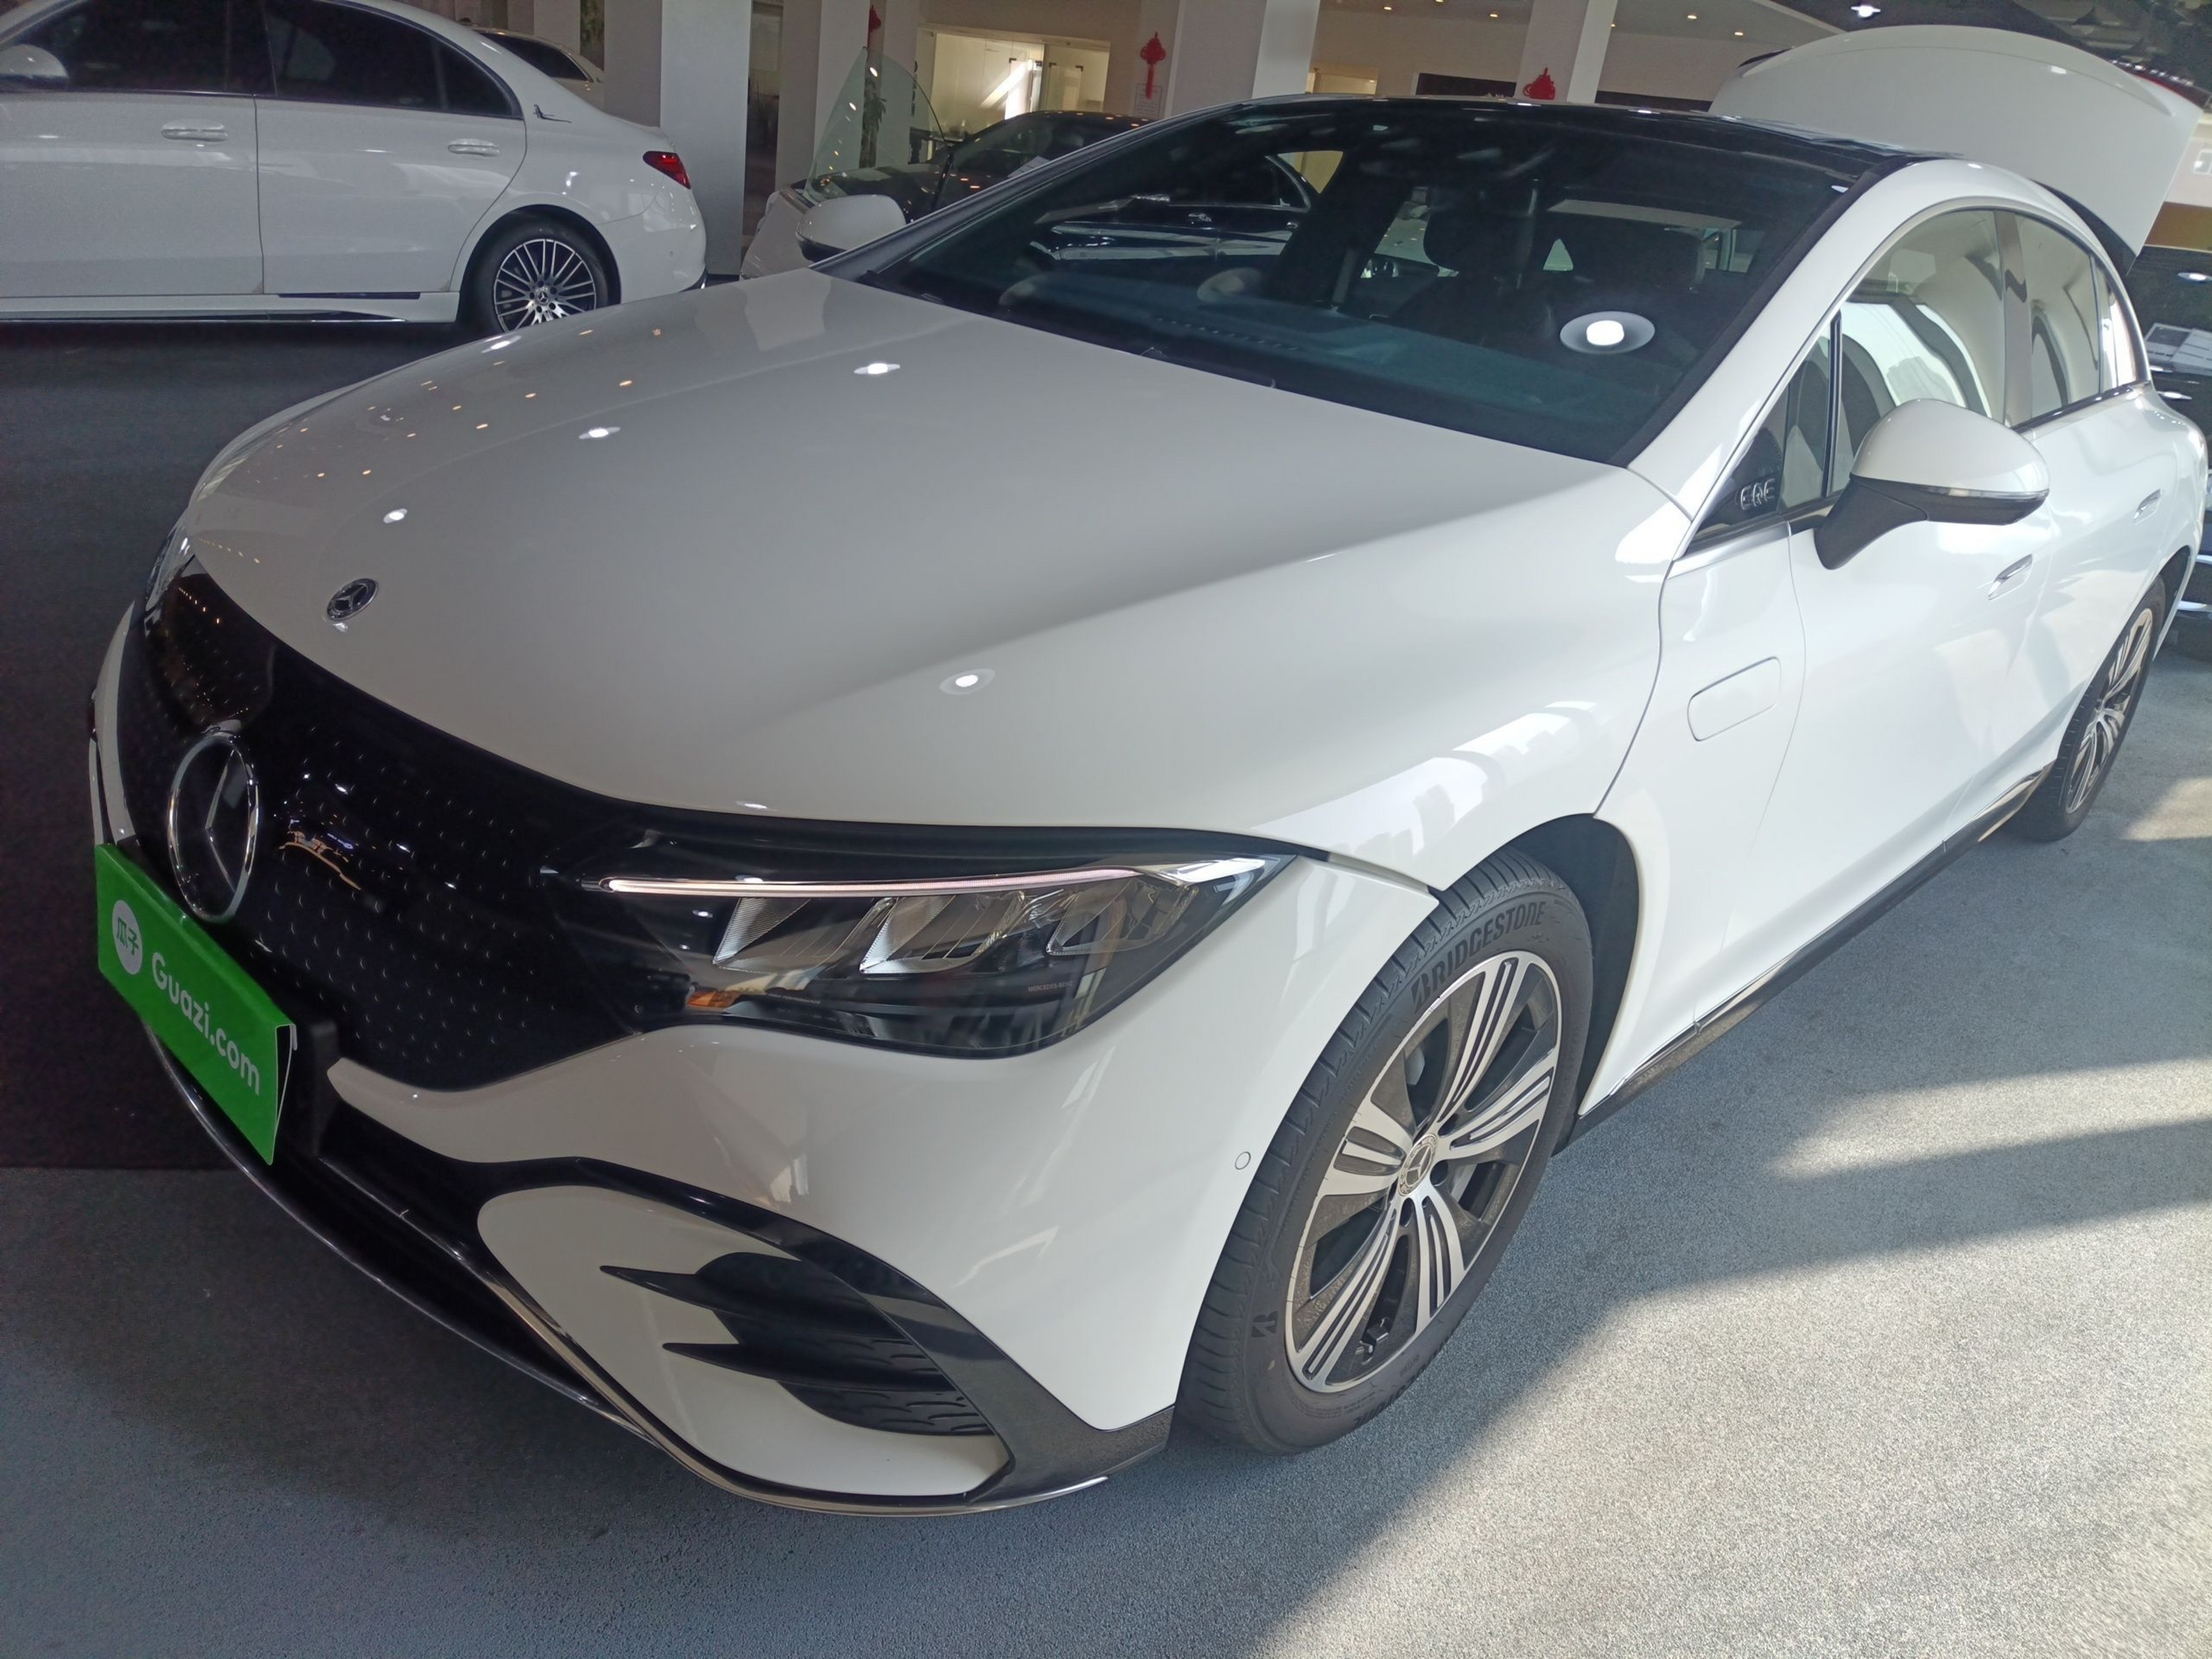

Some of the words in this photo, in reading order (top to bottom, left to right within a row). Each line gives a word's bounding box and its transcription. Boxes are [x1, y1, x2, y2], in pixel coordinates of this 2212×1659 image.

[1740, 478, 1775, 510] EQE
[116, 916, 139, 956] 瓜子
[1411, 900, 1546, 1014] BRIDGESTONE
[152, 952, 260, 1096] Guazi.com
